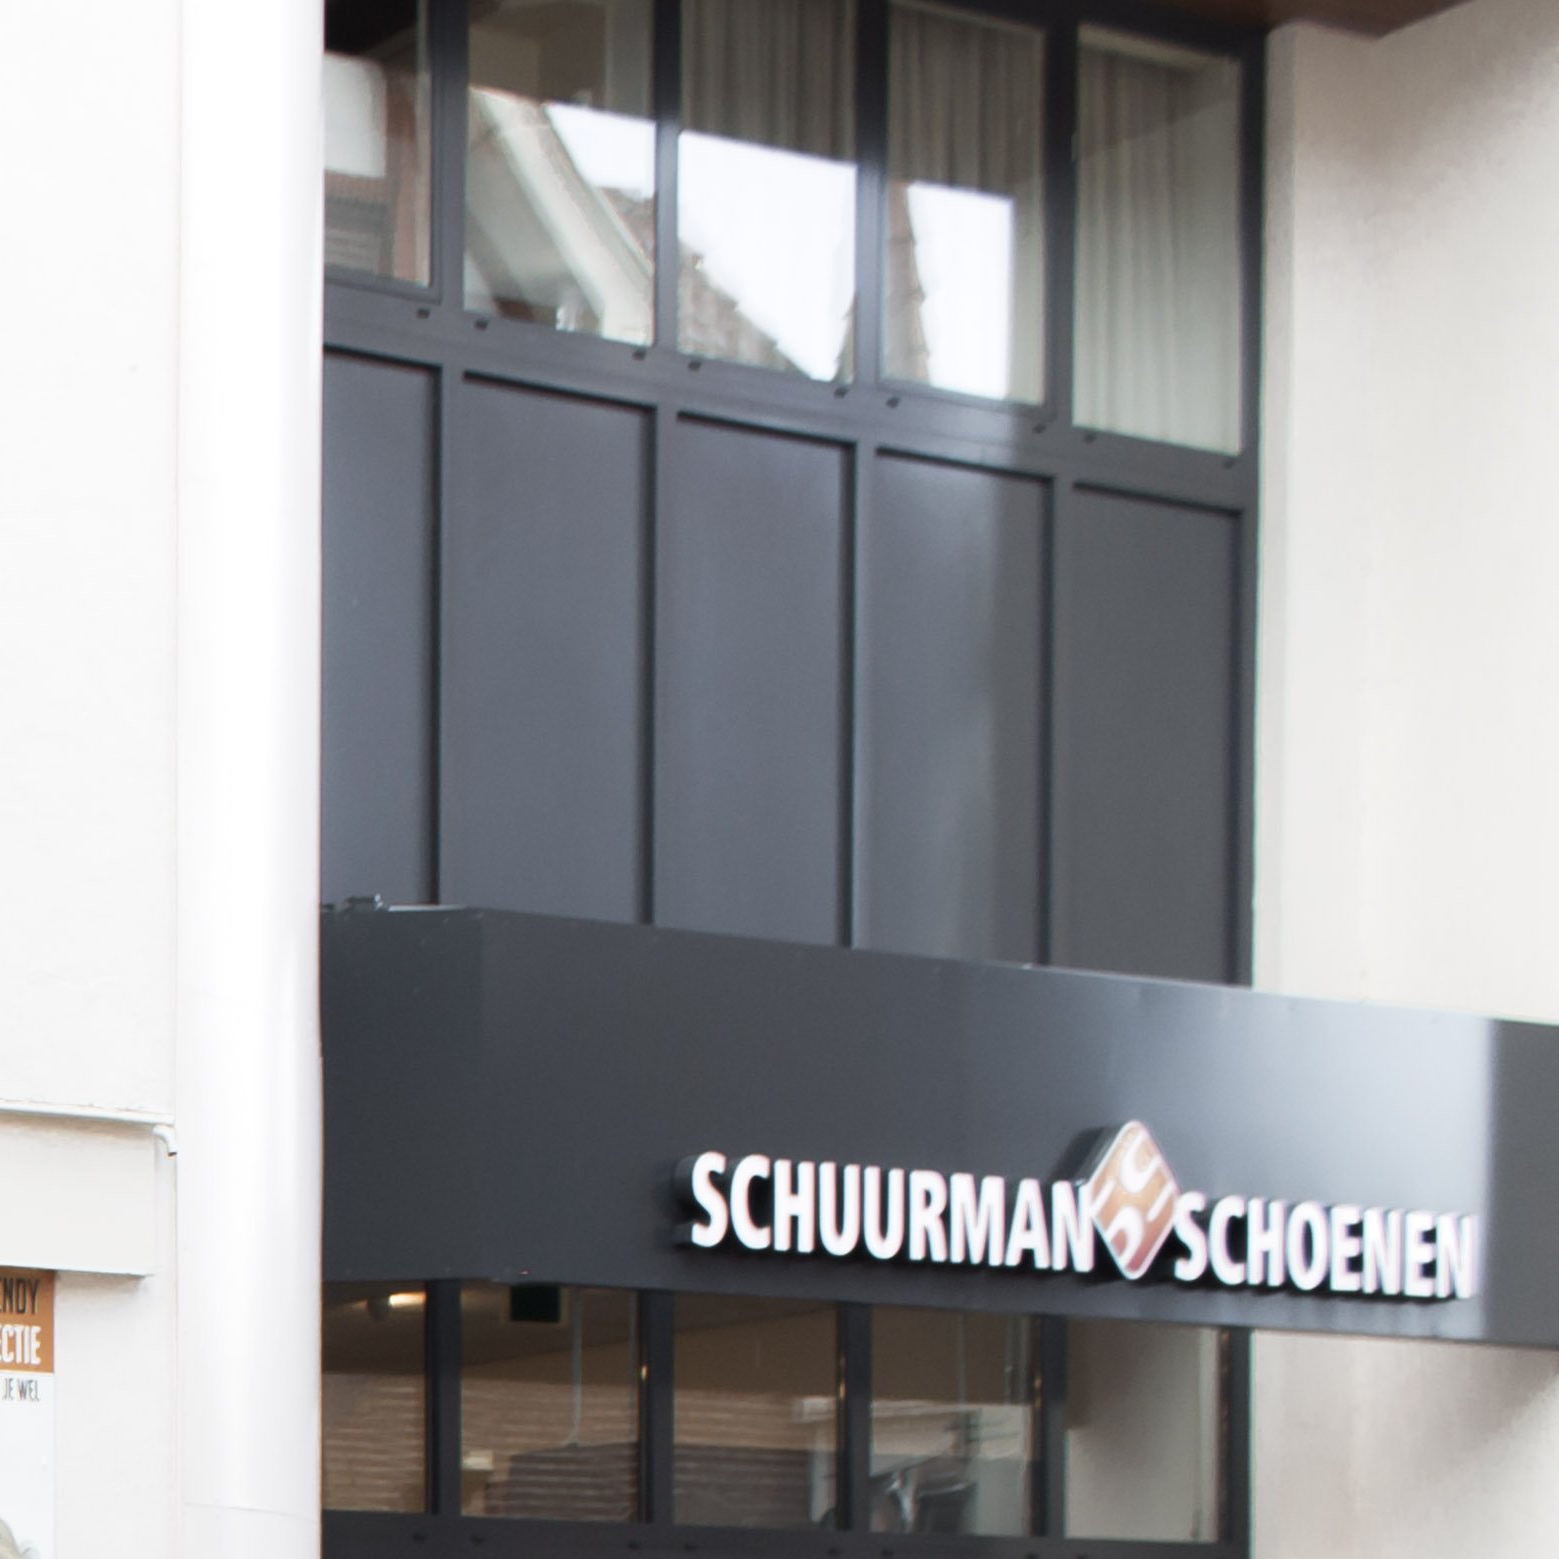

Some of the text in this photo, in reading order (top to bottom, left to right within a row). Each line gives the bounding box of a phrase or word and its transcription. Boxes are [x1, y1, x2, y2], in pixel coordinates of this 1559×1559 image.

[688, 1151, 1479, 1301] SCHUURMAN SCHOENEN
[2, 1377, 15, 1401] JE
[18, 1378, 41, 1402] WEL
